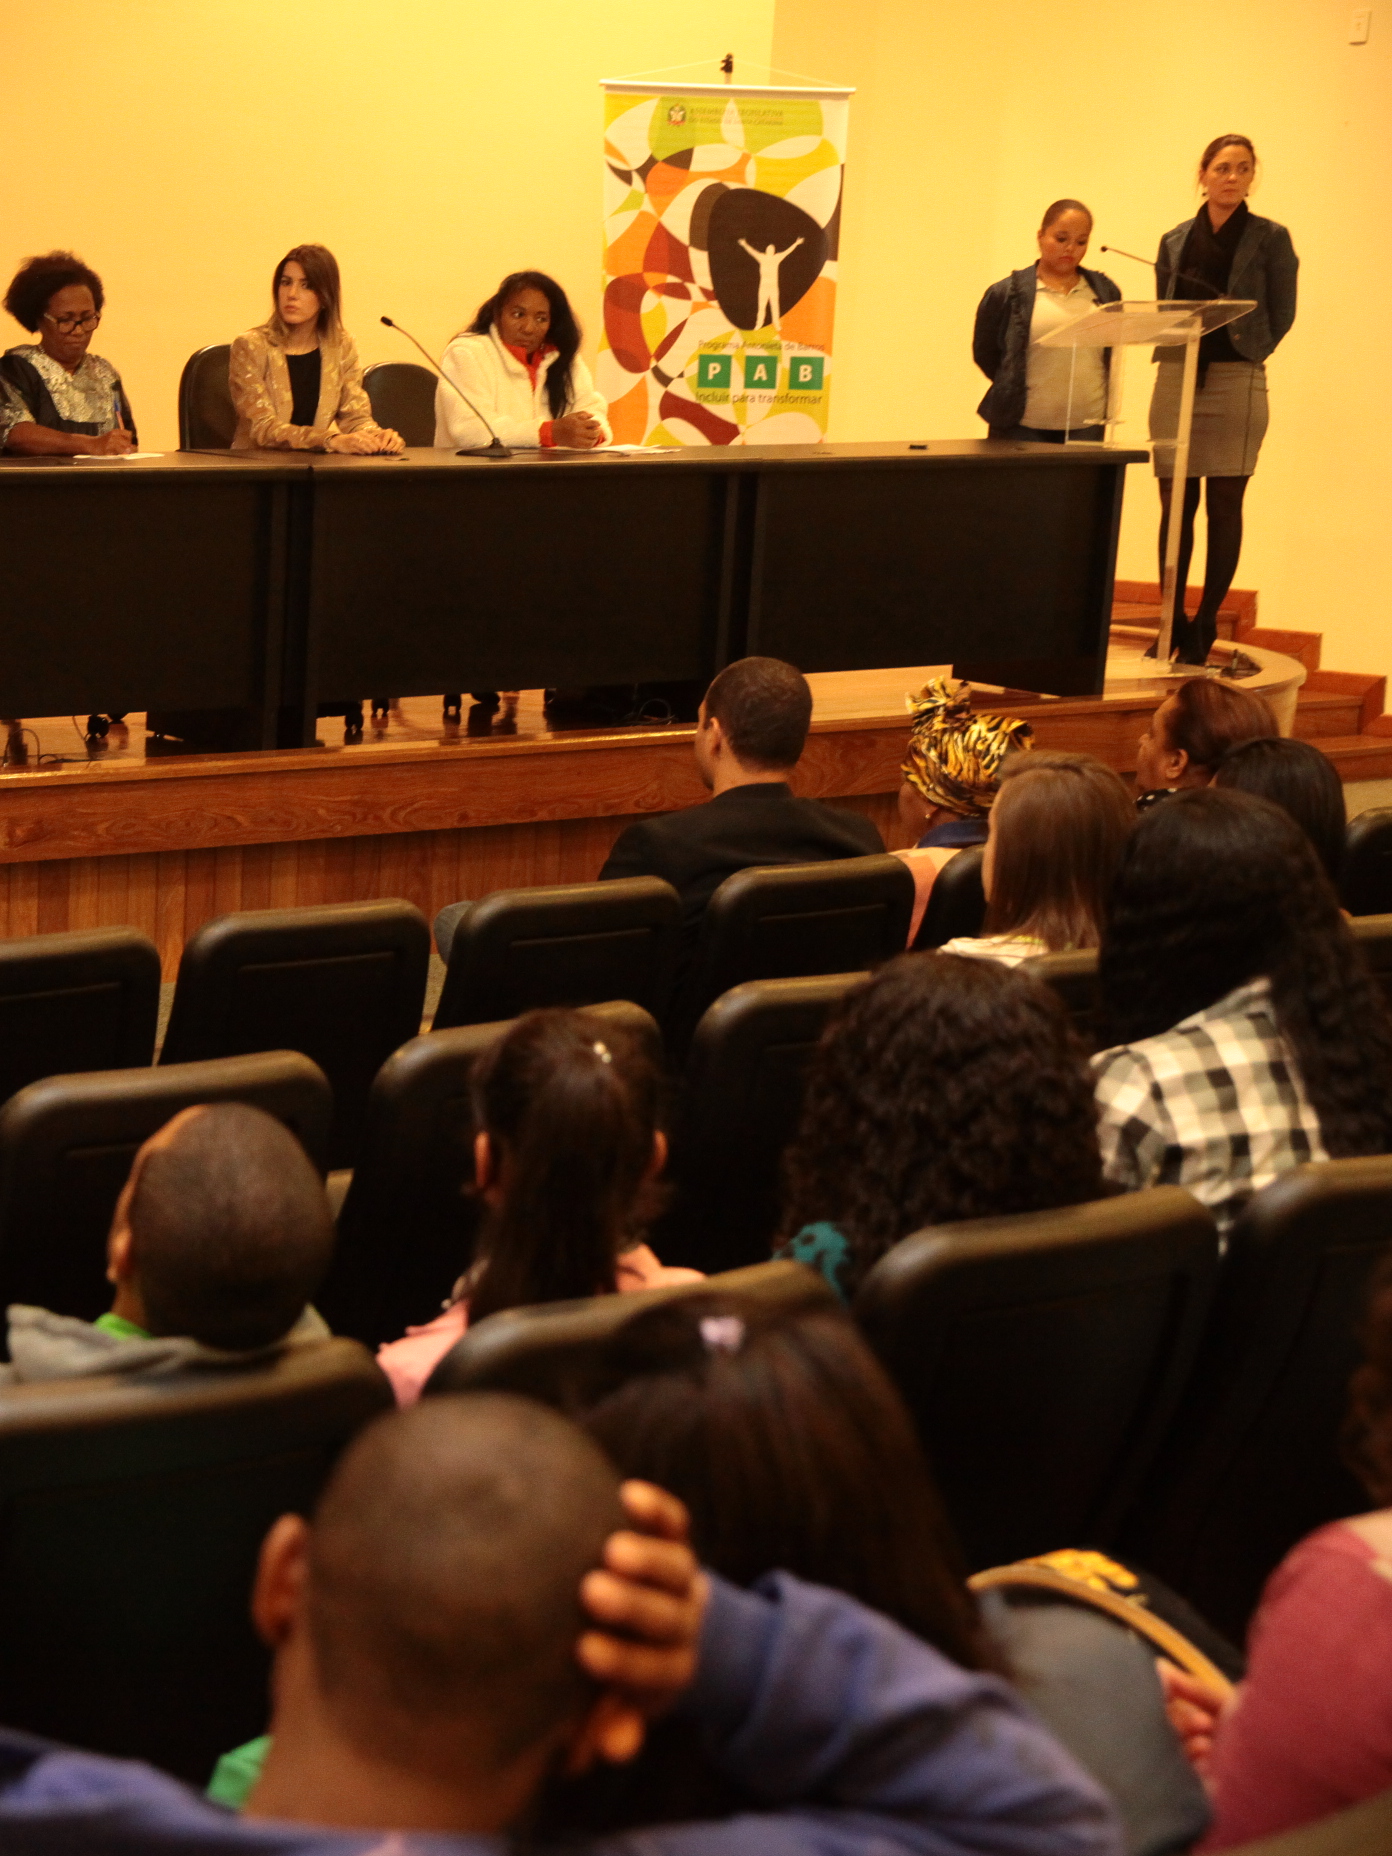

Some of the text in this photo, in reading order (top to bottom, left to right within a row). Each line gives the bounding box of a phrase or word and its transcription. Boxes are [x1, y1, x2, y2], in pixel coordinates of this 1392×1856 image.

[707, 362, 813, 382] P A B
[732, 393, 756, 405] para
[758, 392, 823, 404] transformar
